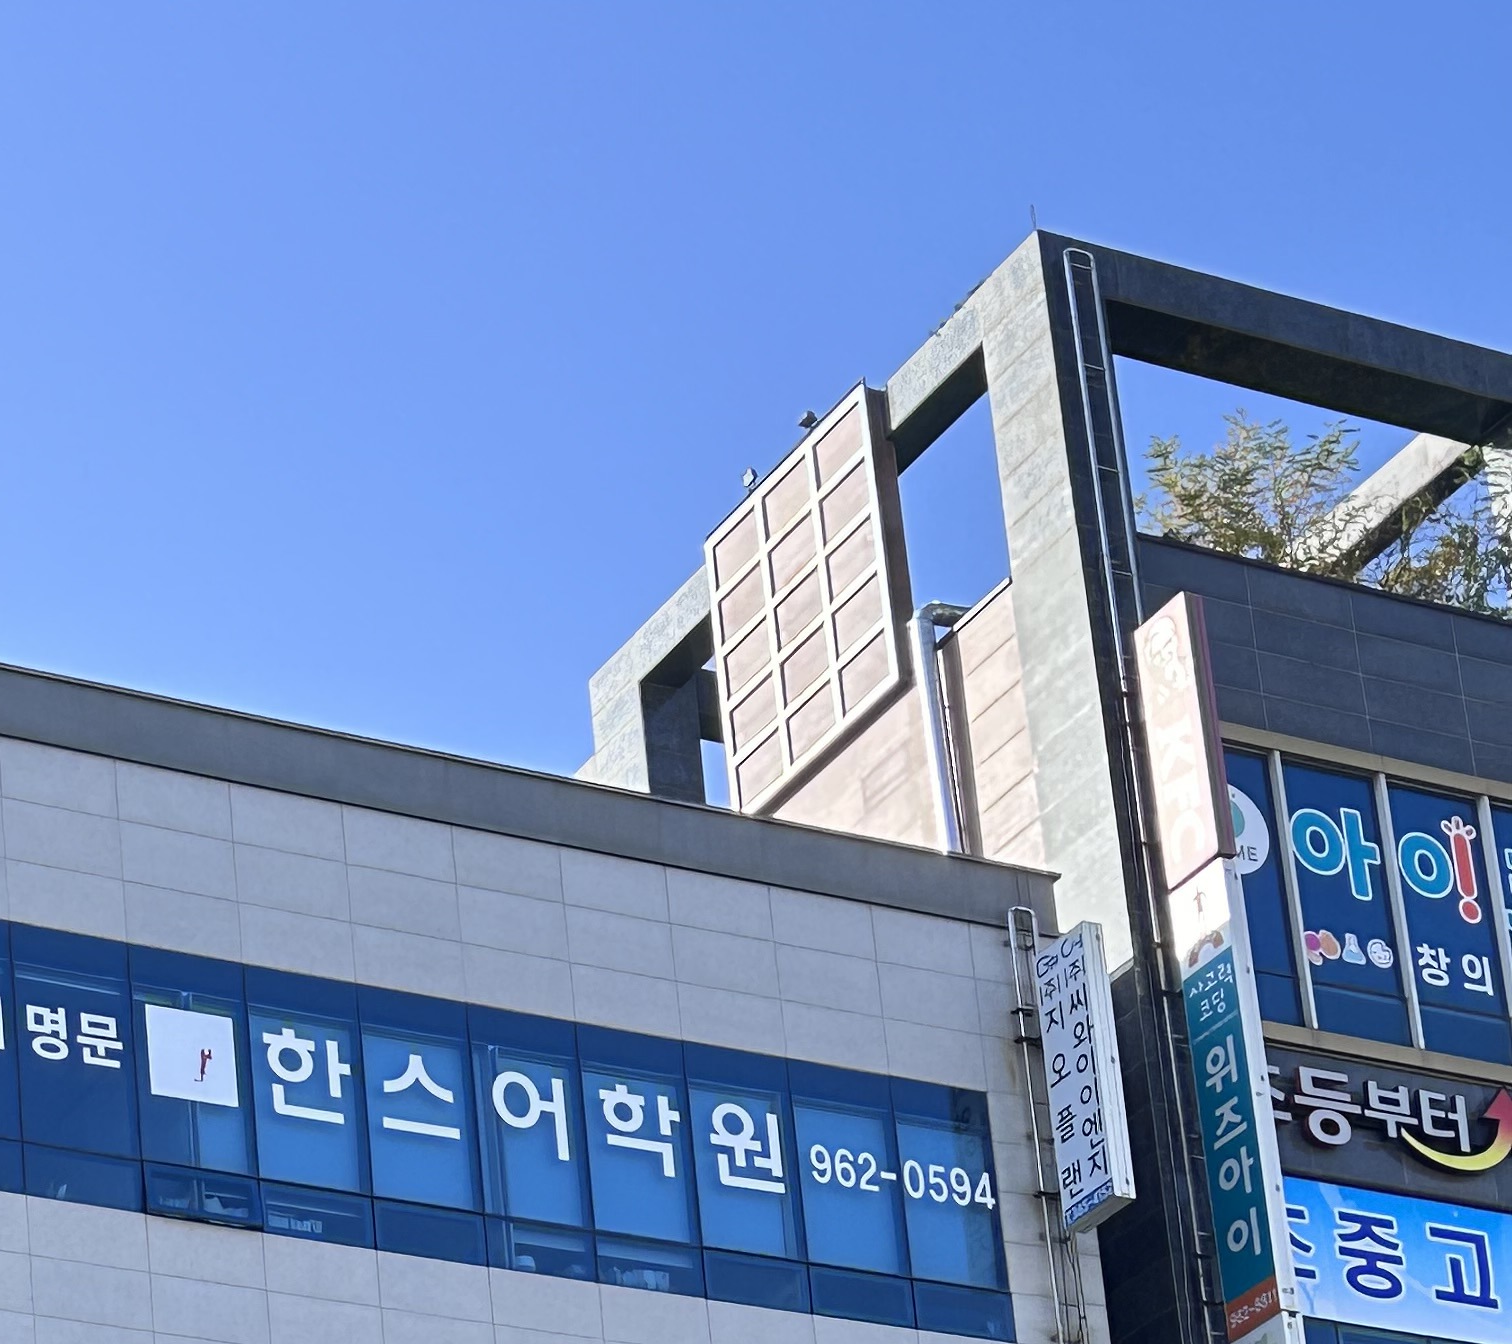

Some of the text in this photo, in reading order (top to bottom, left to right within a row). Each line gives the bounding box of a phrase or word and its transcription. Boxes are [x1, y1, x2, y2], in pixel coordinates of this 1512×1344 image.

[1189, 960, 1234, 999] 사고력
[1416, 942, 1495, 997] 창의
[1199, 990, 1227, 1023] 코딩
[25, 1003, 124, 1069] 명문
[262, 1026, 787, 1194] 한스어학원
[810, 1143, 997, 1210] 962-0594
[1205, 1033, 1262, 1257] 위즈아이
